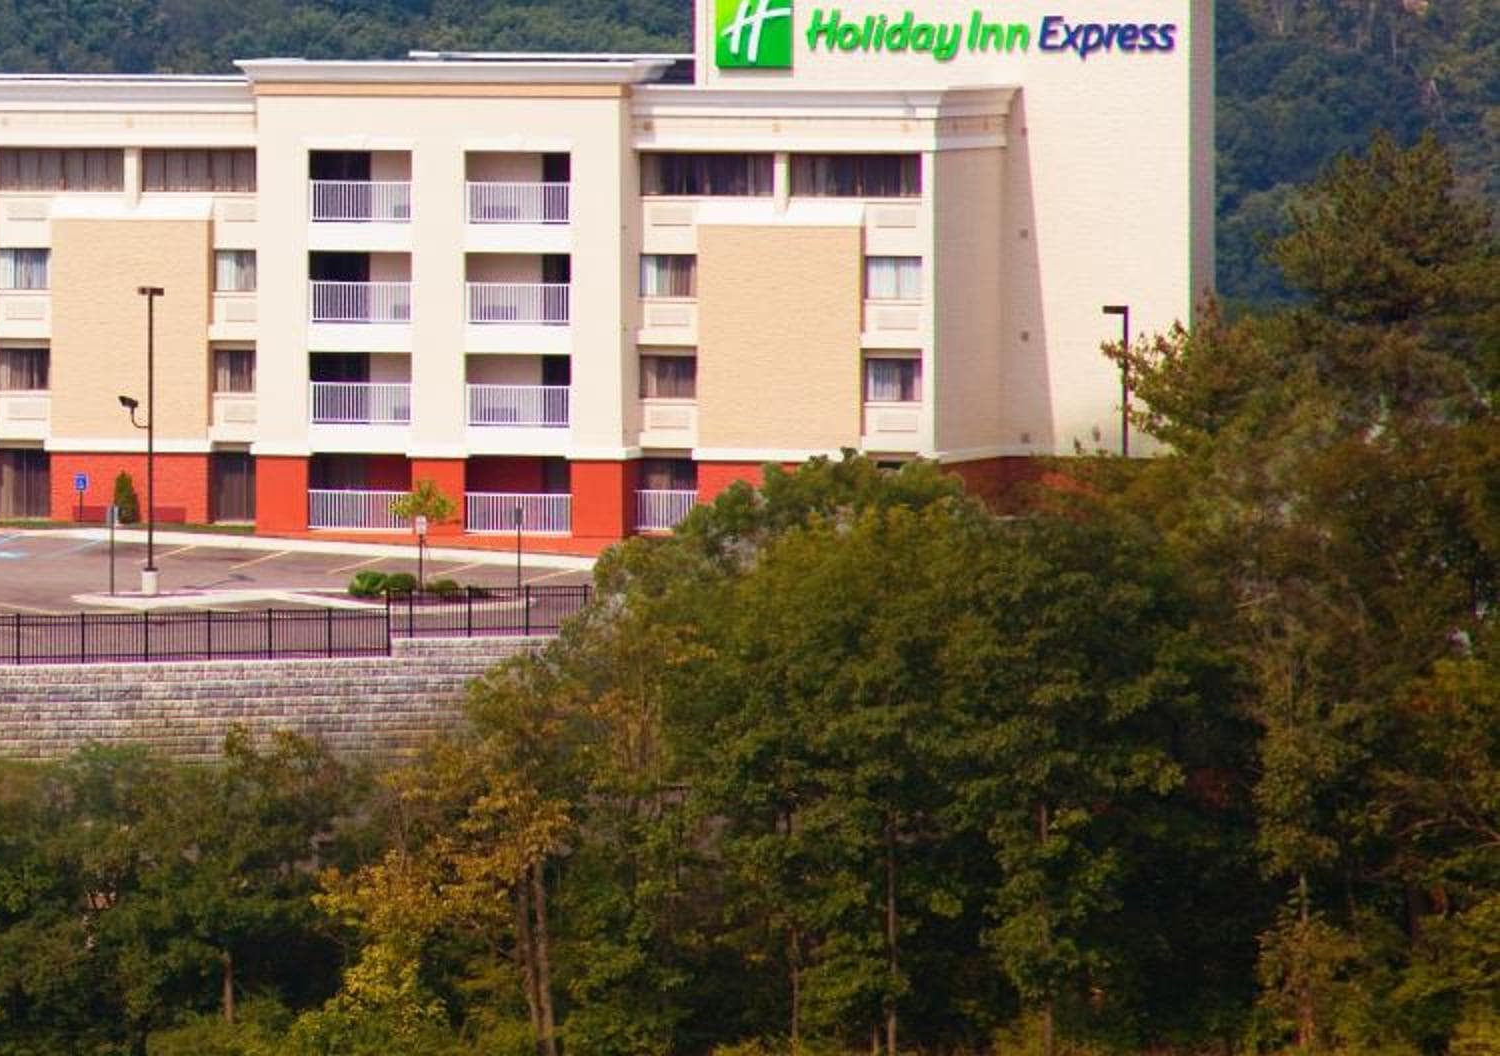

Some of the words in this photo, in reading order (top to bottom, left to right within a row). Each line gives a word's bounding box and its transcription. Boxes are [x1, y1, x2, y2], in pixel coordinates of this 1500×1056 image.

[806, 8, 962, 61] Holiday
[967, 10, 1030, 51] Inn
[1038, 15, 1176, 61] Express
